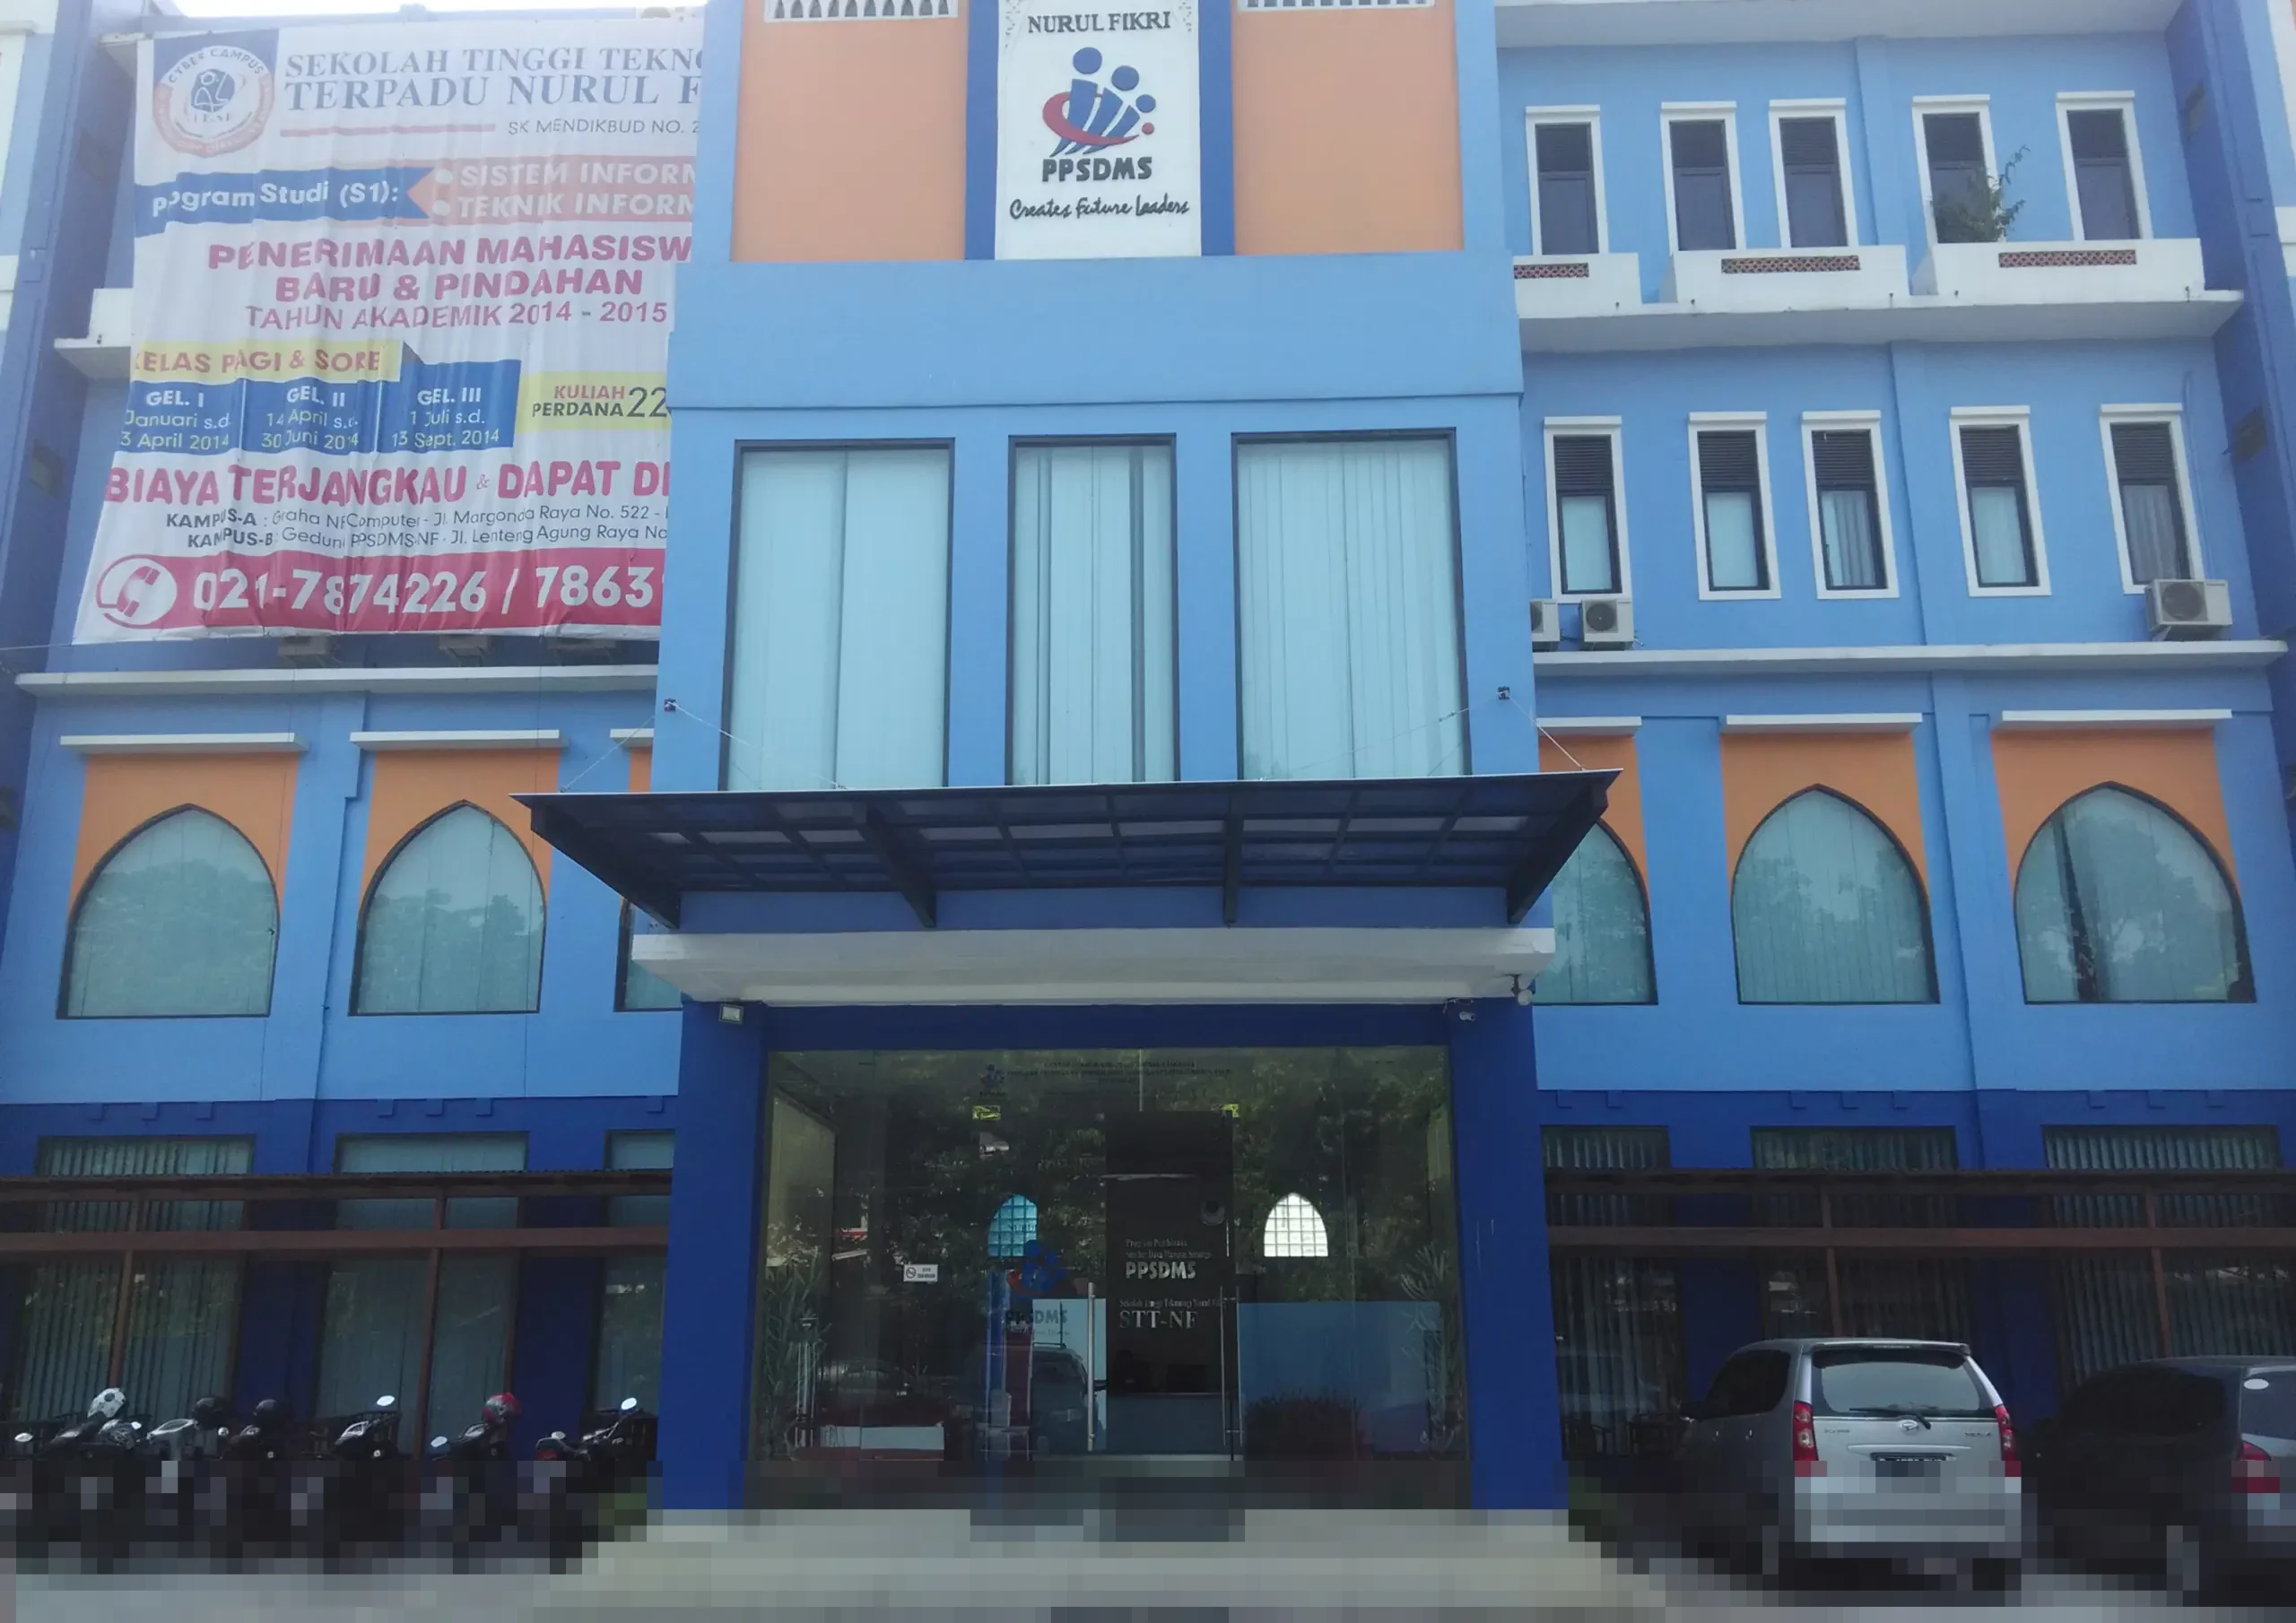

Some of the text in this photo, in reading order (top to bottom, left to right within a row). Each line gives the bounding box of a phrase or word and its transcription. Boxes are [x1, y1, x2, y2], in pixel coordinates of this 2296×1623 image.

[1028, 12, 1171, 33] NURUL FIKRI
[210, 48, 265, 74] CAMPUS
[285, 50, 450, 78] SEKOLAH
[463, 48, 586, 72] TINGGI
[284, 76, 489, 111] TERPADU
[508, 74, 659, 105] NURUL
[508, 120, 530, 136] SK
[535, 118, 645, 134] MENDIKBUD
[651, 120, 685, 134] NO.
[461, 163, 567, 187] SISTEM
[1042, 156, 1152, 182] PPSDMS
[152, 180, 398, 218] Pogram Studi (S1):
[457, 193, 565, 218] TEKNIK
[1010, 193, 1189, 220] Creates Future Leaders
[208, 234, 692, 270] PENERIMAAN MAHASISW
[275, 268, 643, 302] BARU & PINDAHAN
[246, 304, 343, 330] TAHUN
[352, 305, 502, 329] AKADEMIK
[508, 301, 572, 325] 2014
[599, 301, 667, 323] 2015
[222, 350, 282, 373] PAGI
[289, 350, 305, 369] &
[315, 349, 380, 371] SORE
[146, 390, 204, 408] GEL. I
[286, 386, 345, 407] GEL. II
[416, 386, 482, 405] GEL. III
[553, 386, 625, 400] KULIAH
[125, 410, 197, 429] Januari
[266, 412, 284, 427] 14
[288, 408, 327, 427] April
[410, 409, 485, 427] 1 Juli s.d.
[532, 402, 623, 418] PERDANA
[136, 432, 183, 450] April
[189, 433, 230, 449] 2014
[261, 432, 282, 447] 30
[284, 430, 318, 447] Juni
[391, 428, 500, 449] 13 Sept. 2014
[104, 467, 220, 506] BIAYA
[228, 464, 467, 506] TERJANGKAU
[476, 473, 491, 490] &
[498, 459, 621, 499] DAPAT
[166, 508, 257, 528] KAMPUS-A
[272, 509, 319, 525] Graha
[454, 508, 535, 527] Margonda
[539, 505, 580, 522] Raya
[586, 505, 614, 519] No.
[620, 506, 649, 519] 522
[187, 527, 274, 548] KAMPUS-B
[282, 527, 345, 549] Gedun
[451, 530, 466, 544] Jl.
[472, 527, 533, 543] Lenteng
[537, 525, 591, 542] Agung
[596, 525, 639, 542] Raya
[193, 566, 665, 615] 021-7874226 / 7863
[1126, 1261, 1196, 1280] PPSDMS
[1118, 1310, 1198, 1329] STT-NF
